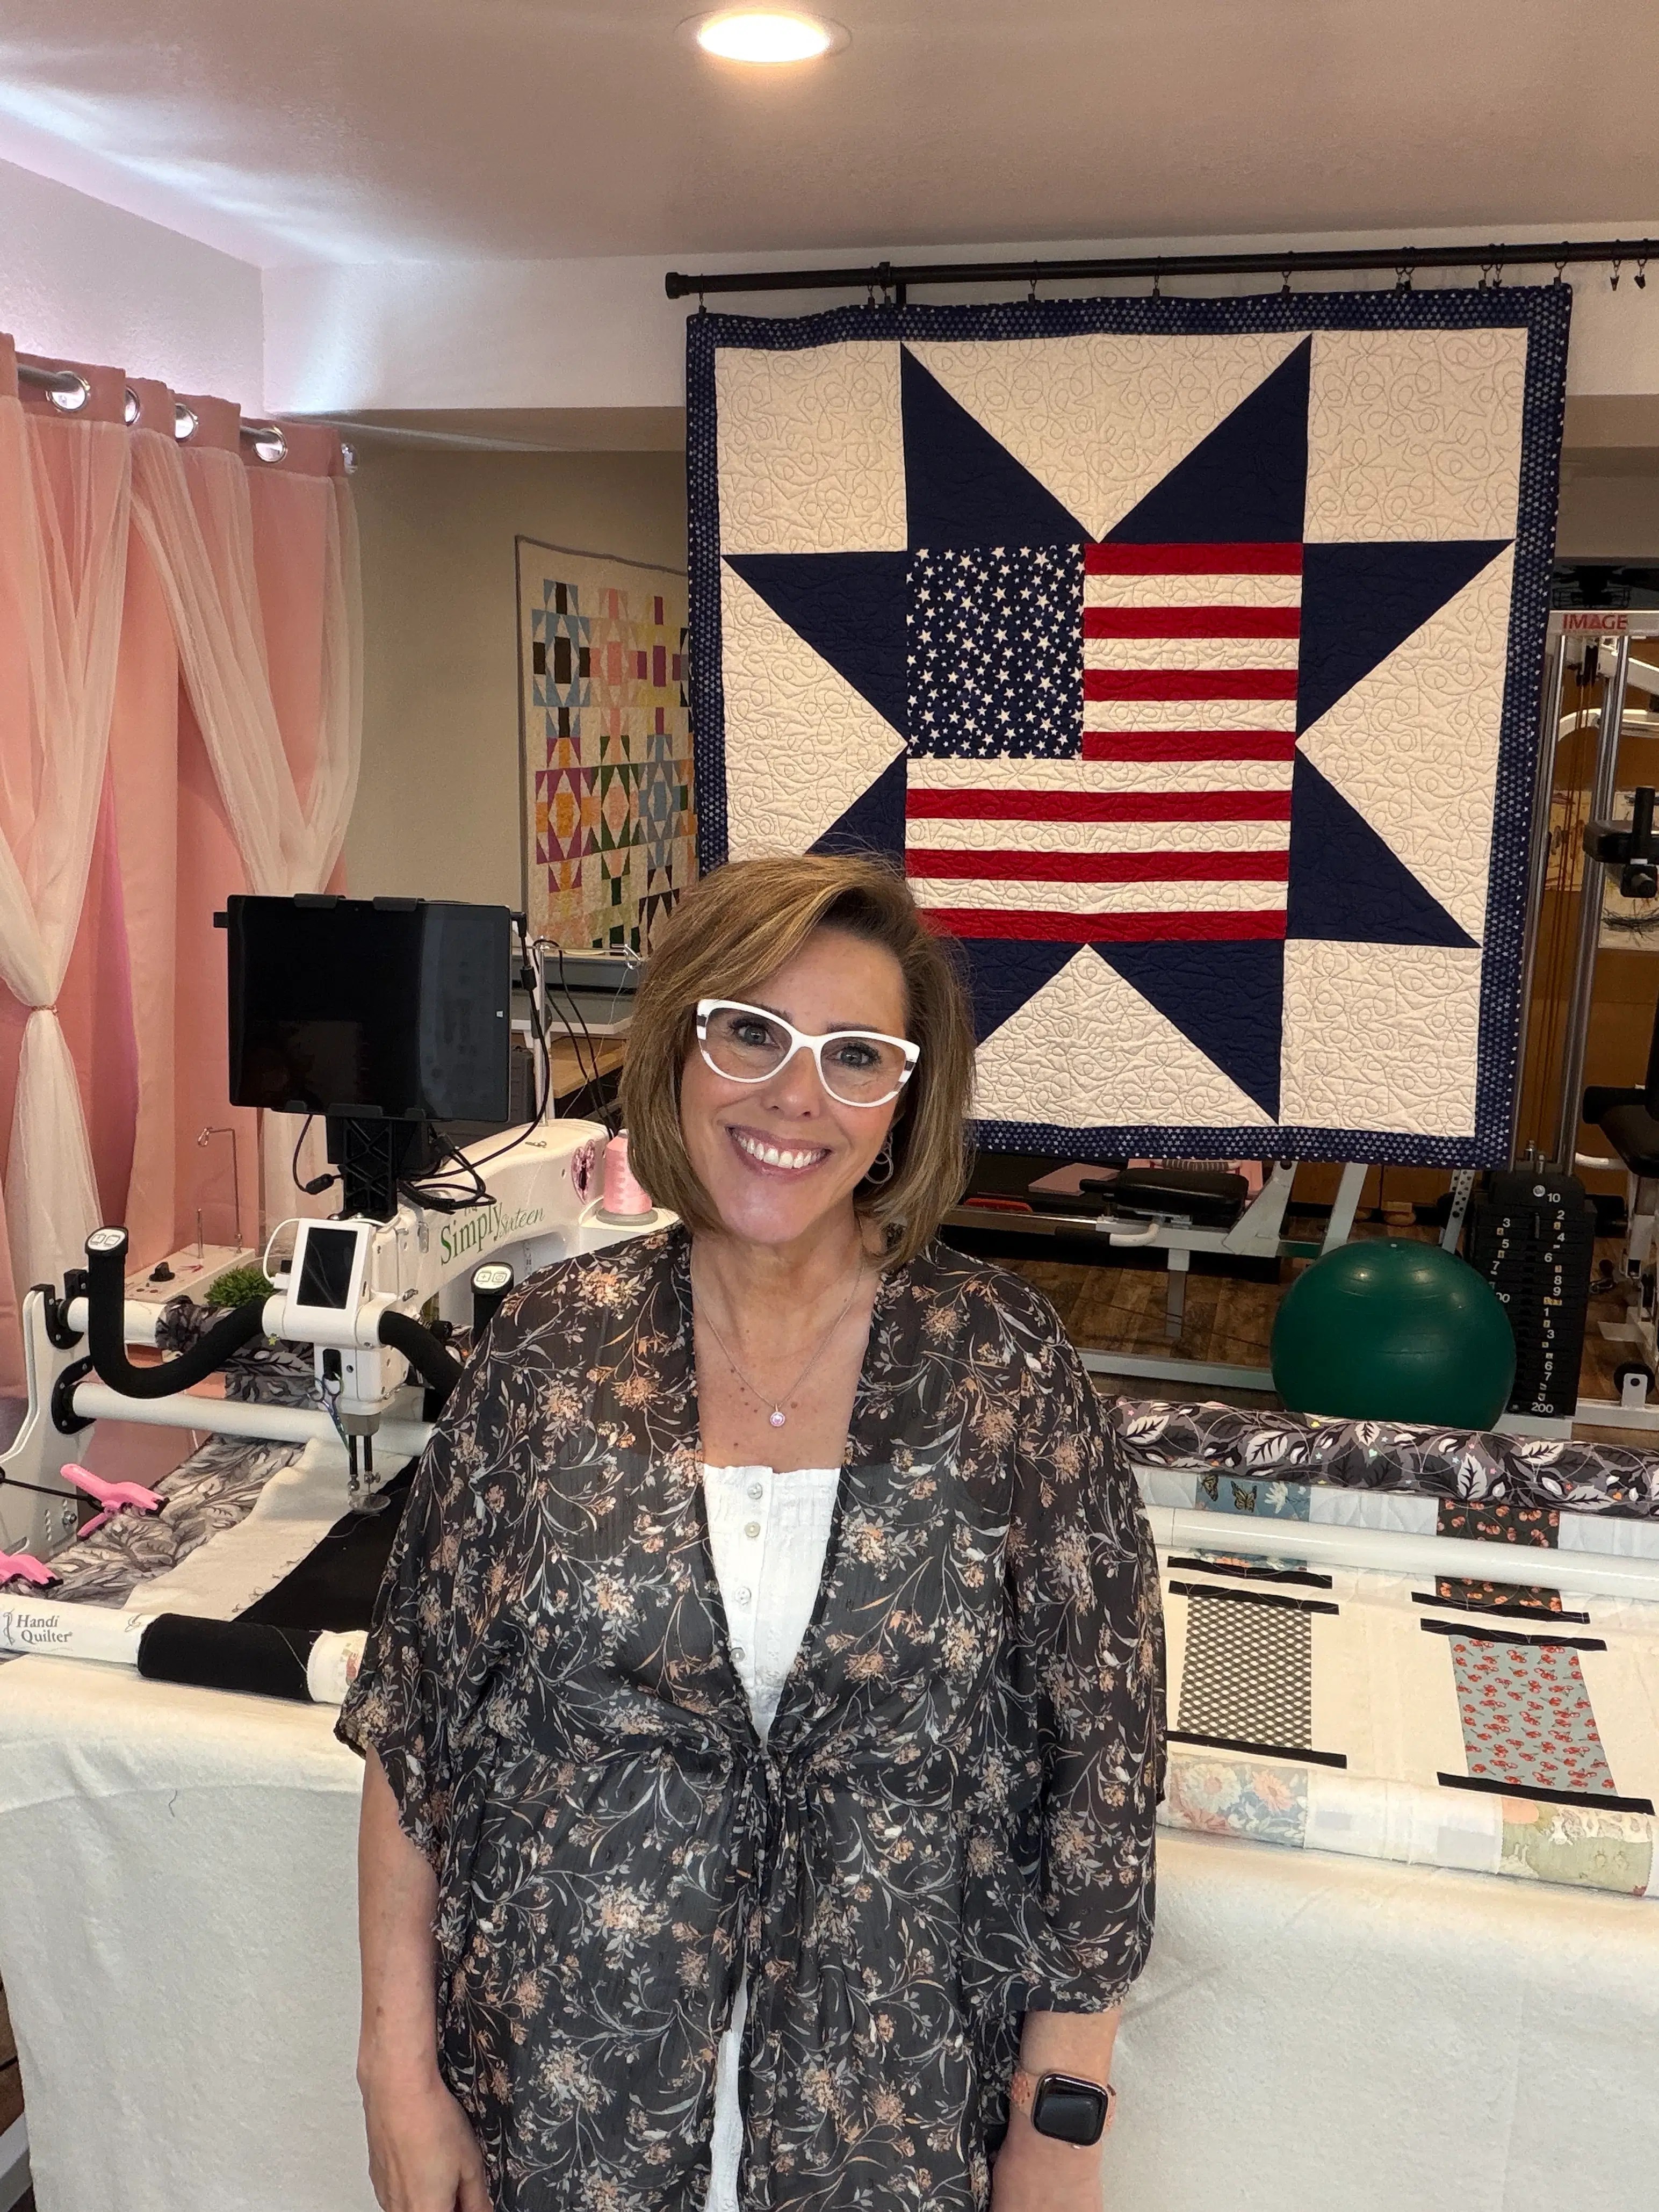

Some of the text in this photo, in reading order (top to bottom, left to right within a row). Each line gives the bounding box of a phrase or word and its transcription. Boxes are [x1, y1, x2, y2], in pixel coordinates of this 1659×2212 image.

[1563, 614, 1628, 630] IMAGE
[1548, 1193, 1560, 1202] 10
[1557, 1211, 1564, 1220] 2
[1503, 1218, 1510, 1227] 3
[441, 1202, 502, 1266] Simply
[1557, 1233, 1564, 1241] 4
[1502, 1239, 1509, 1248] 5
[1545, 1253, 1552, 1262] 6
[1493, 1261, 1499, 1270] 7
[1554, 1276, 1562, 1285] 8
[1553, 1287, 1561, 1295] 9
[1544, 1308, 1548, 1316] 1
[1547, 1330, 1554, 1338] 3
[1545, 1361, 1552, 1370] 6
[1545, 1372, 1552, 1381] 7
[1532, 1402, 1553, 1413] 200
[16, 1615, 60, 1627] Handi
